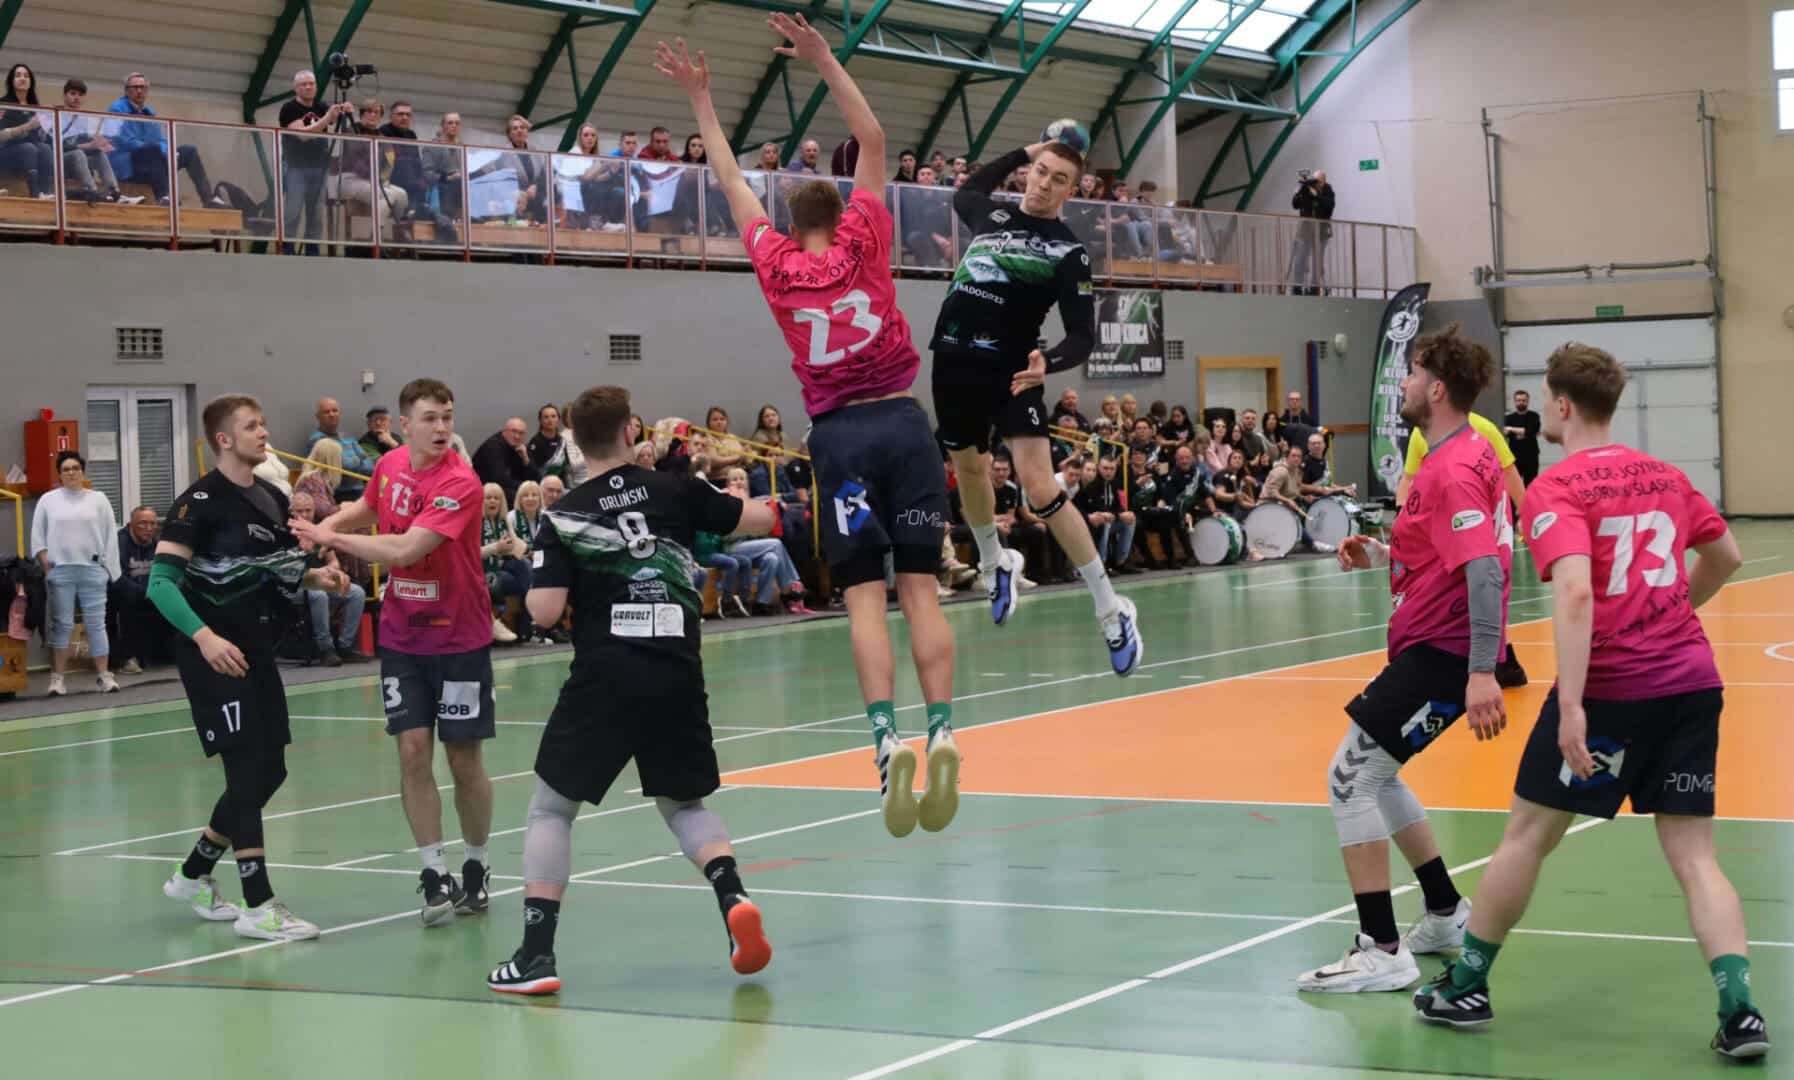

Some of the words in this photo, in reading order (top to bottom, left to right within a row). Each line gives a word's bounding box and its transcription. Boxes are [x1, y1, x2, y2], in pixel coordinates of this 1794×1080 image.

[792, 289, 882, 366] 23
[1028, 407, 1040, 425] 3
[599, 486, 649, 511] ORLIŃSKI
[617, 511, 657, 559] 8
[1597, 510, 1678, 597] 73
[222, 700, 241, 733] 17
